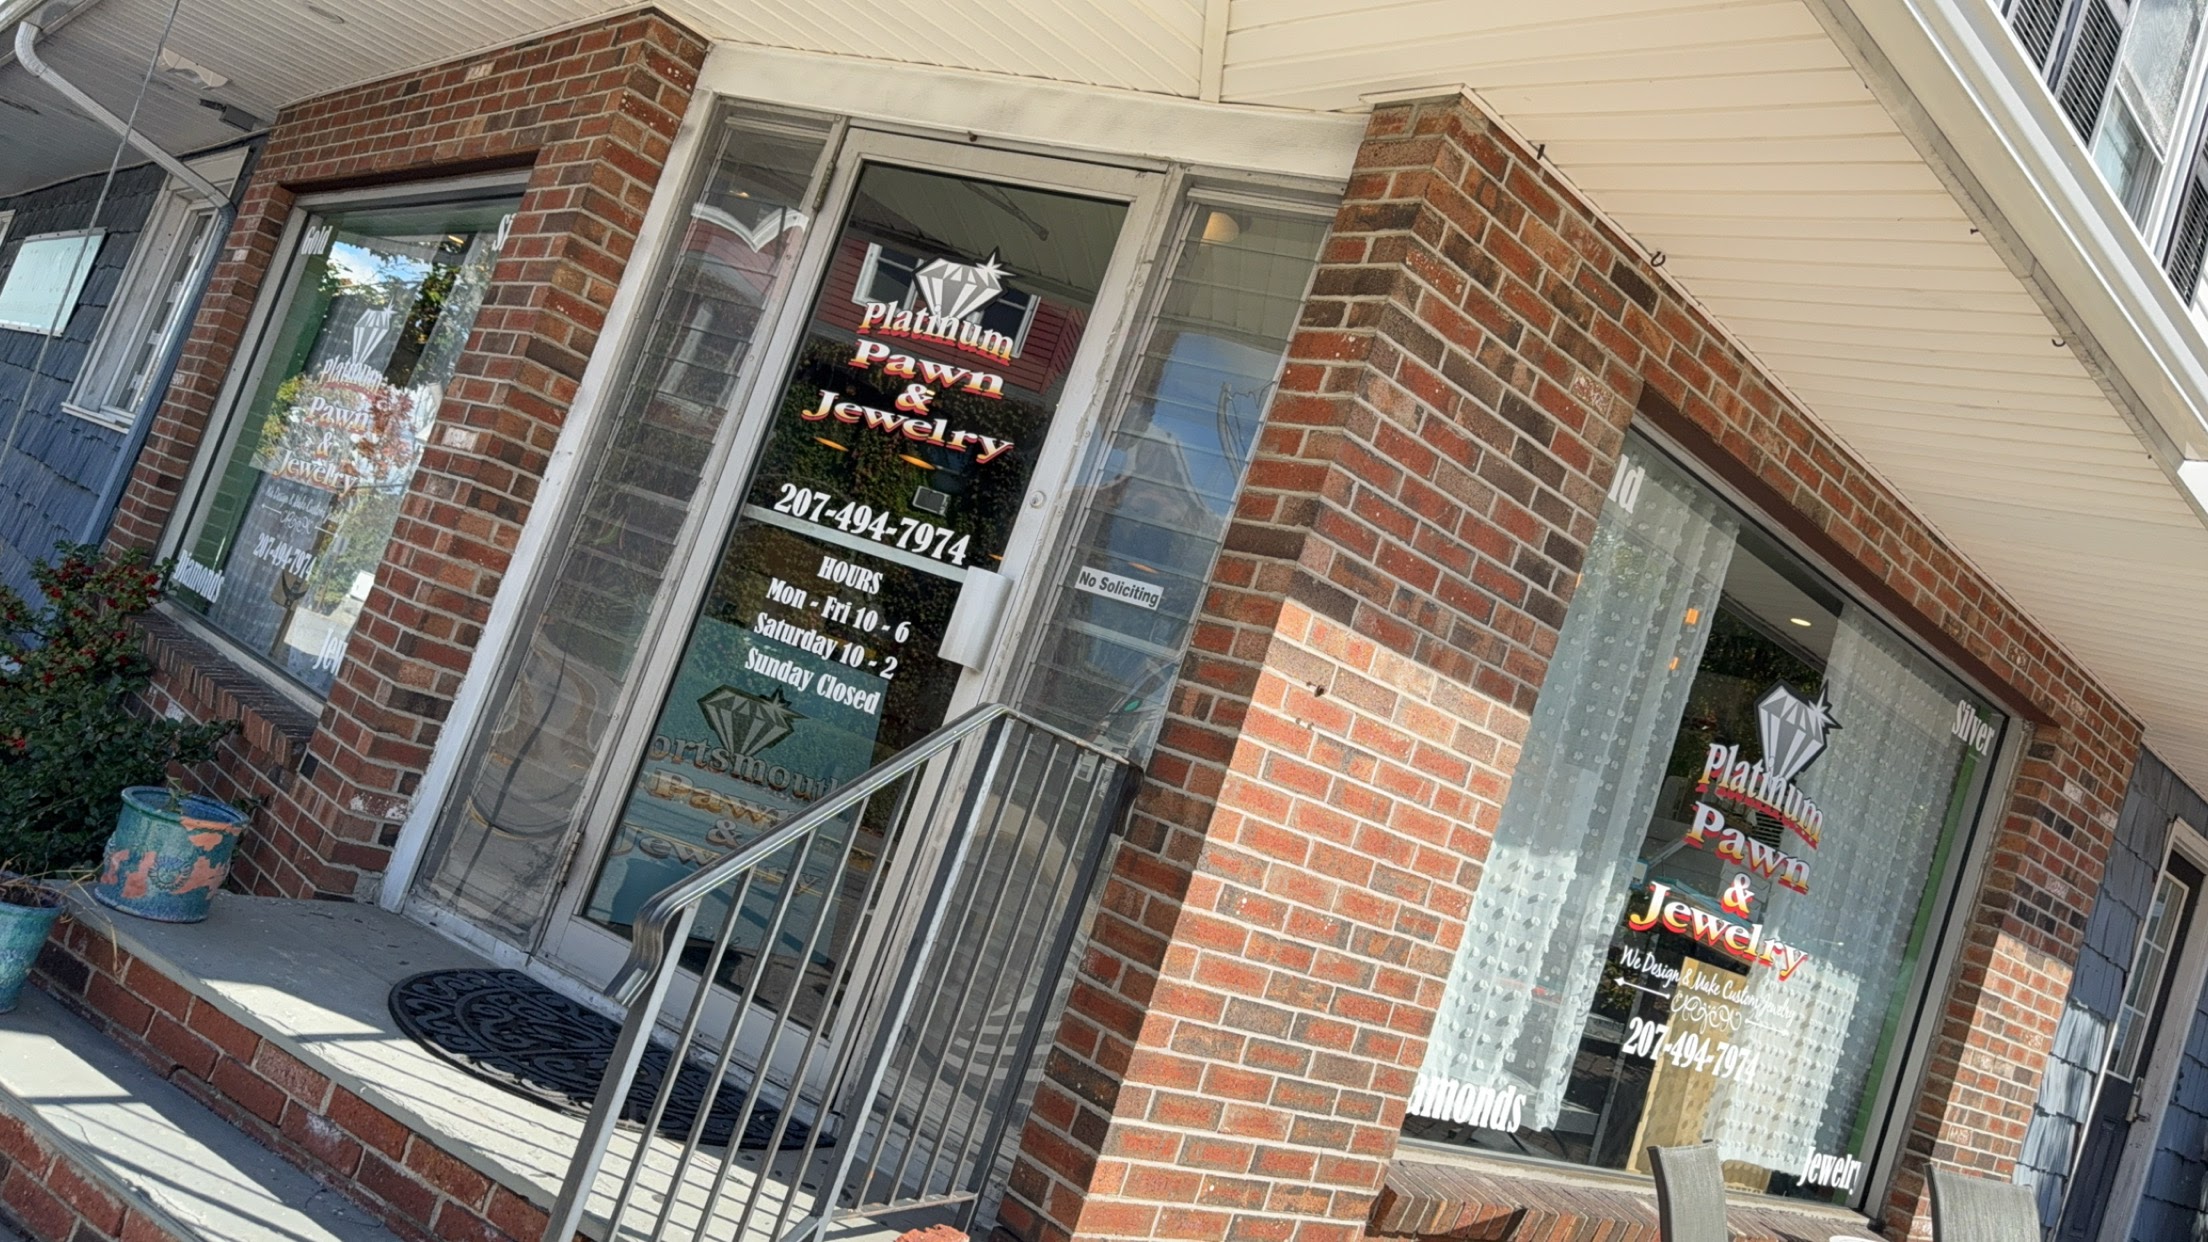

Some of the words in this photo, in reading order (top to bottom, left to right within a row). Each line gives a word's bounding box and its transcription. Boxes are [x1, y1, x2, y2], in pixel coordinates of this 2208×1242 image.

[301, 225, 333, 255] Gold
[856, 301, 1013, 367] Platinum
[848, 338, 1006, 399] Pawn
[895, 382, 936, 416] &
[304, 396, 371, 435] Pawn
[802, 389, 1014, 465] Jewelry
[272, 450, 358, 498] Jewelry
[1607, 453, 1646, 514] ld
[773, 483, 971, 566] 207-494-7974
[173, 549, 225, 603] Diamonds
[817, 555, 884, 595] HOURS
[1079, 571, 1097, 587] No
[1099, 576, 1160, 608] Soliciting
[766, 577, 807, 609] Mon
[821, 596, 853, 624] Fri
[852, 607, 879, 632] 10
[894, 621, 912, 643] 6
[754, 612, 838, 661] Saturday
[839, 642, 865, 668] 10
[880, 656, 898, 680] 2
[745, 647, 815, 692] Sunday
[816, 673, 881, 715] Closed
[1951, 699, 1996, 756] Silver
[650, 733, 840, 803] ortsmout
[1695, 742, 1824, 850] Platinum
[706, 818, 745, 849] &
[1682, 800, 1811, 895] Pawn
[1720, 872, 1754, 919] &
[1628, 880, 1808, 981] Jewelry
[1620, 945, 1642, 970] We
[1641, 952, 1681, 988] Design
[1680, 968, 1691, 986] &
[1689, 970, 1721, 996] Make
[1722, 979, 1760, 1007] Custom
[1621, 1016, 1758, 1082] 207-494-7974
[1406, 1072, 1528, 1134] amonds
